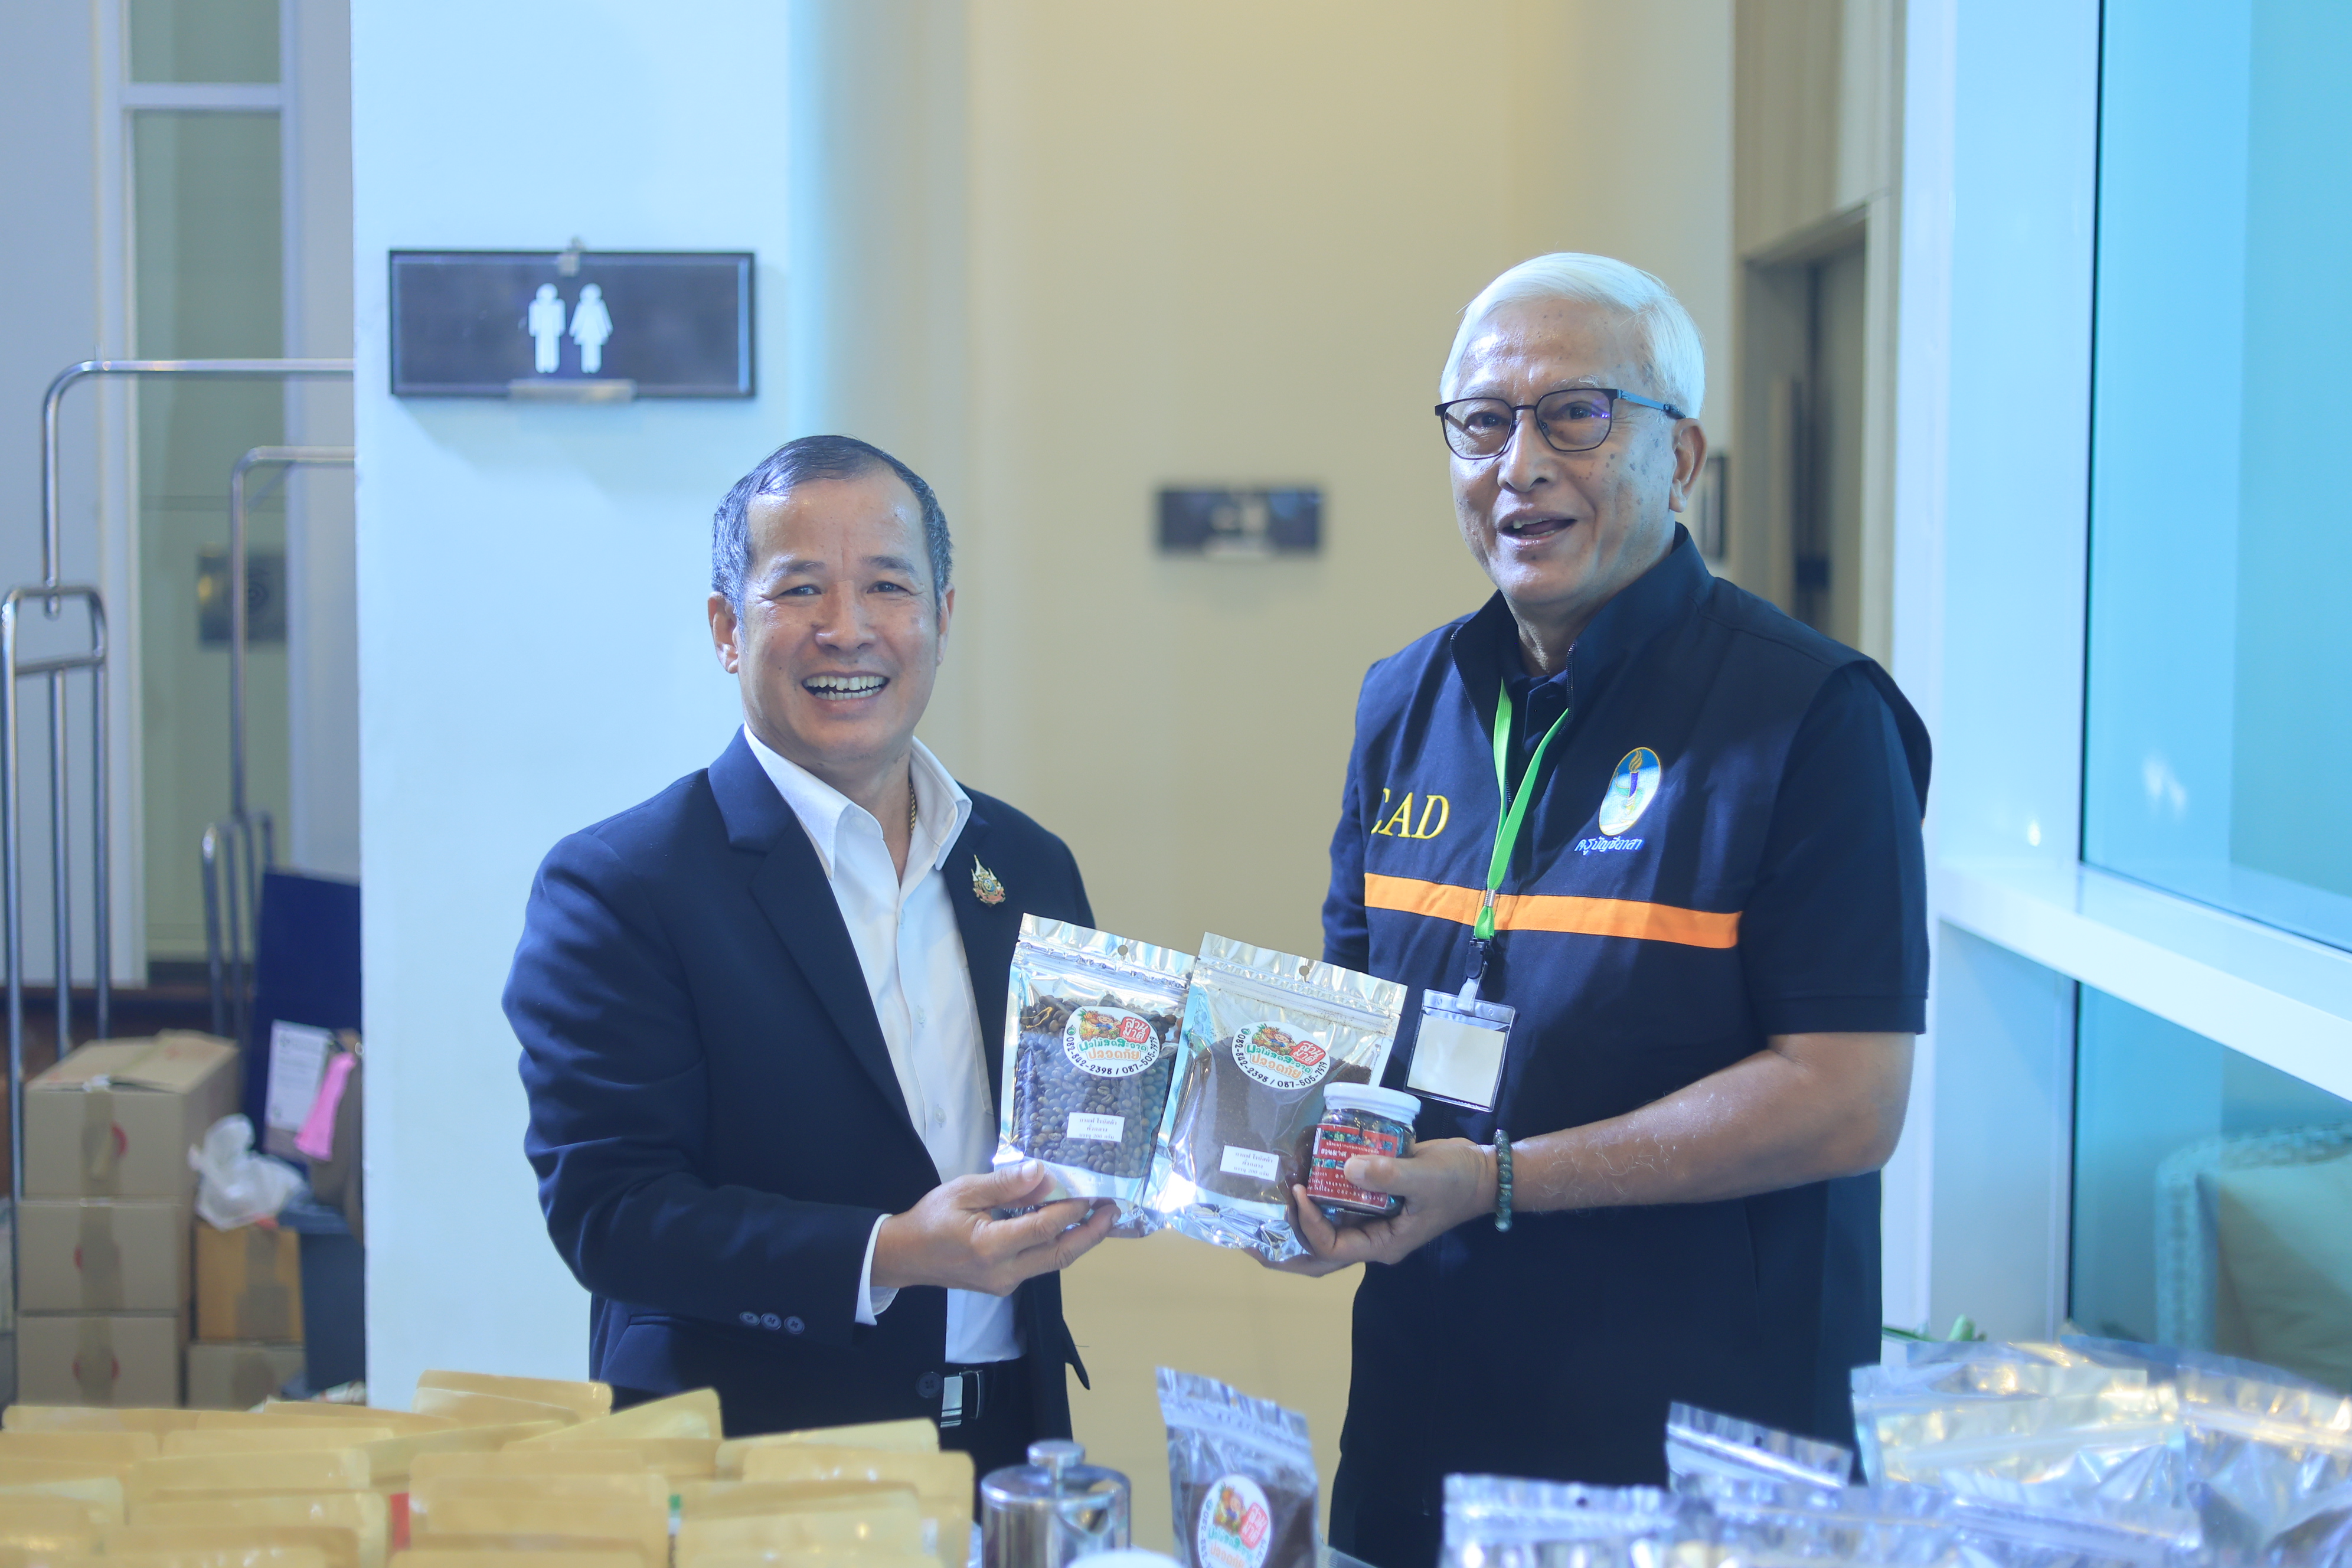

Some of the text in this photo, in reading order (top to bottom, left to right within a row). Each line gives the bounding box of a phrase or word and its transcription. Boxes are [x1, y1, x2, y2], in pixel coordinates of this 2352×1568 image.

[1574, 836, 1642, 855] ครูบัญชีอาสา
[1125, 1018, 1148, 1033] สวน
[1079, 1037, 1148, 1052] ผลไม้สดสะอาด
[1087, 1048, 1140, 1060] ปลอดภัย
[1299, 1042, 1324, 1057] สวน
[1066, 1037, 1112, 1075] 082-842-2398
[1235, 1034, 1269, 1083] 082-842-2398
[1246, 1044, 1311, 1074] ผลไม้สดสะอาด
[1252, 1054, 1303, 1079] ปลอดภัย
